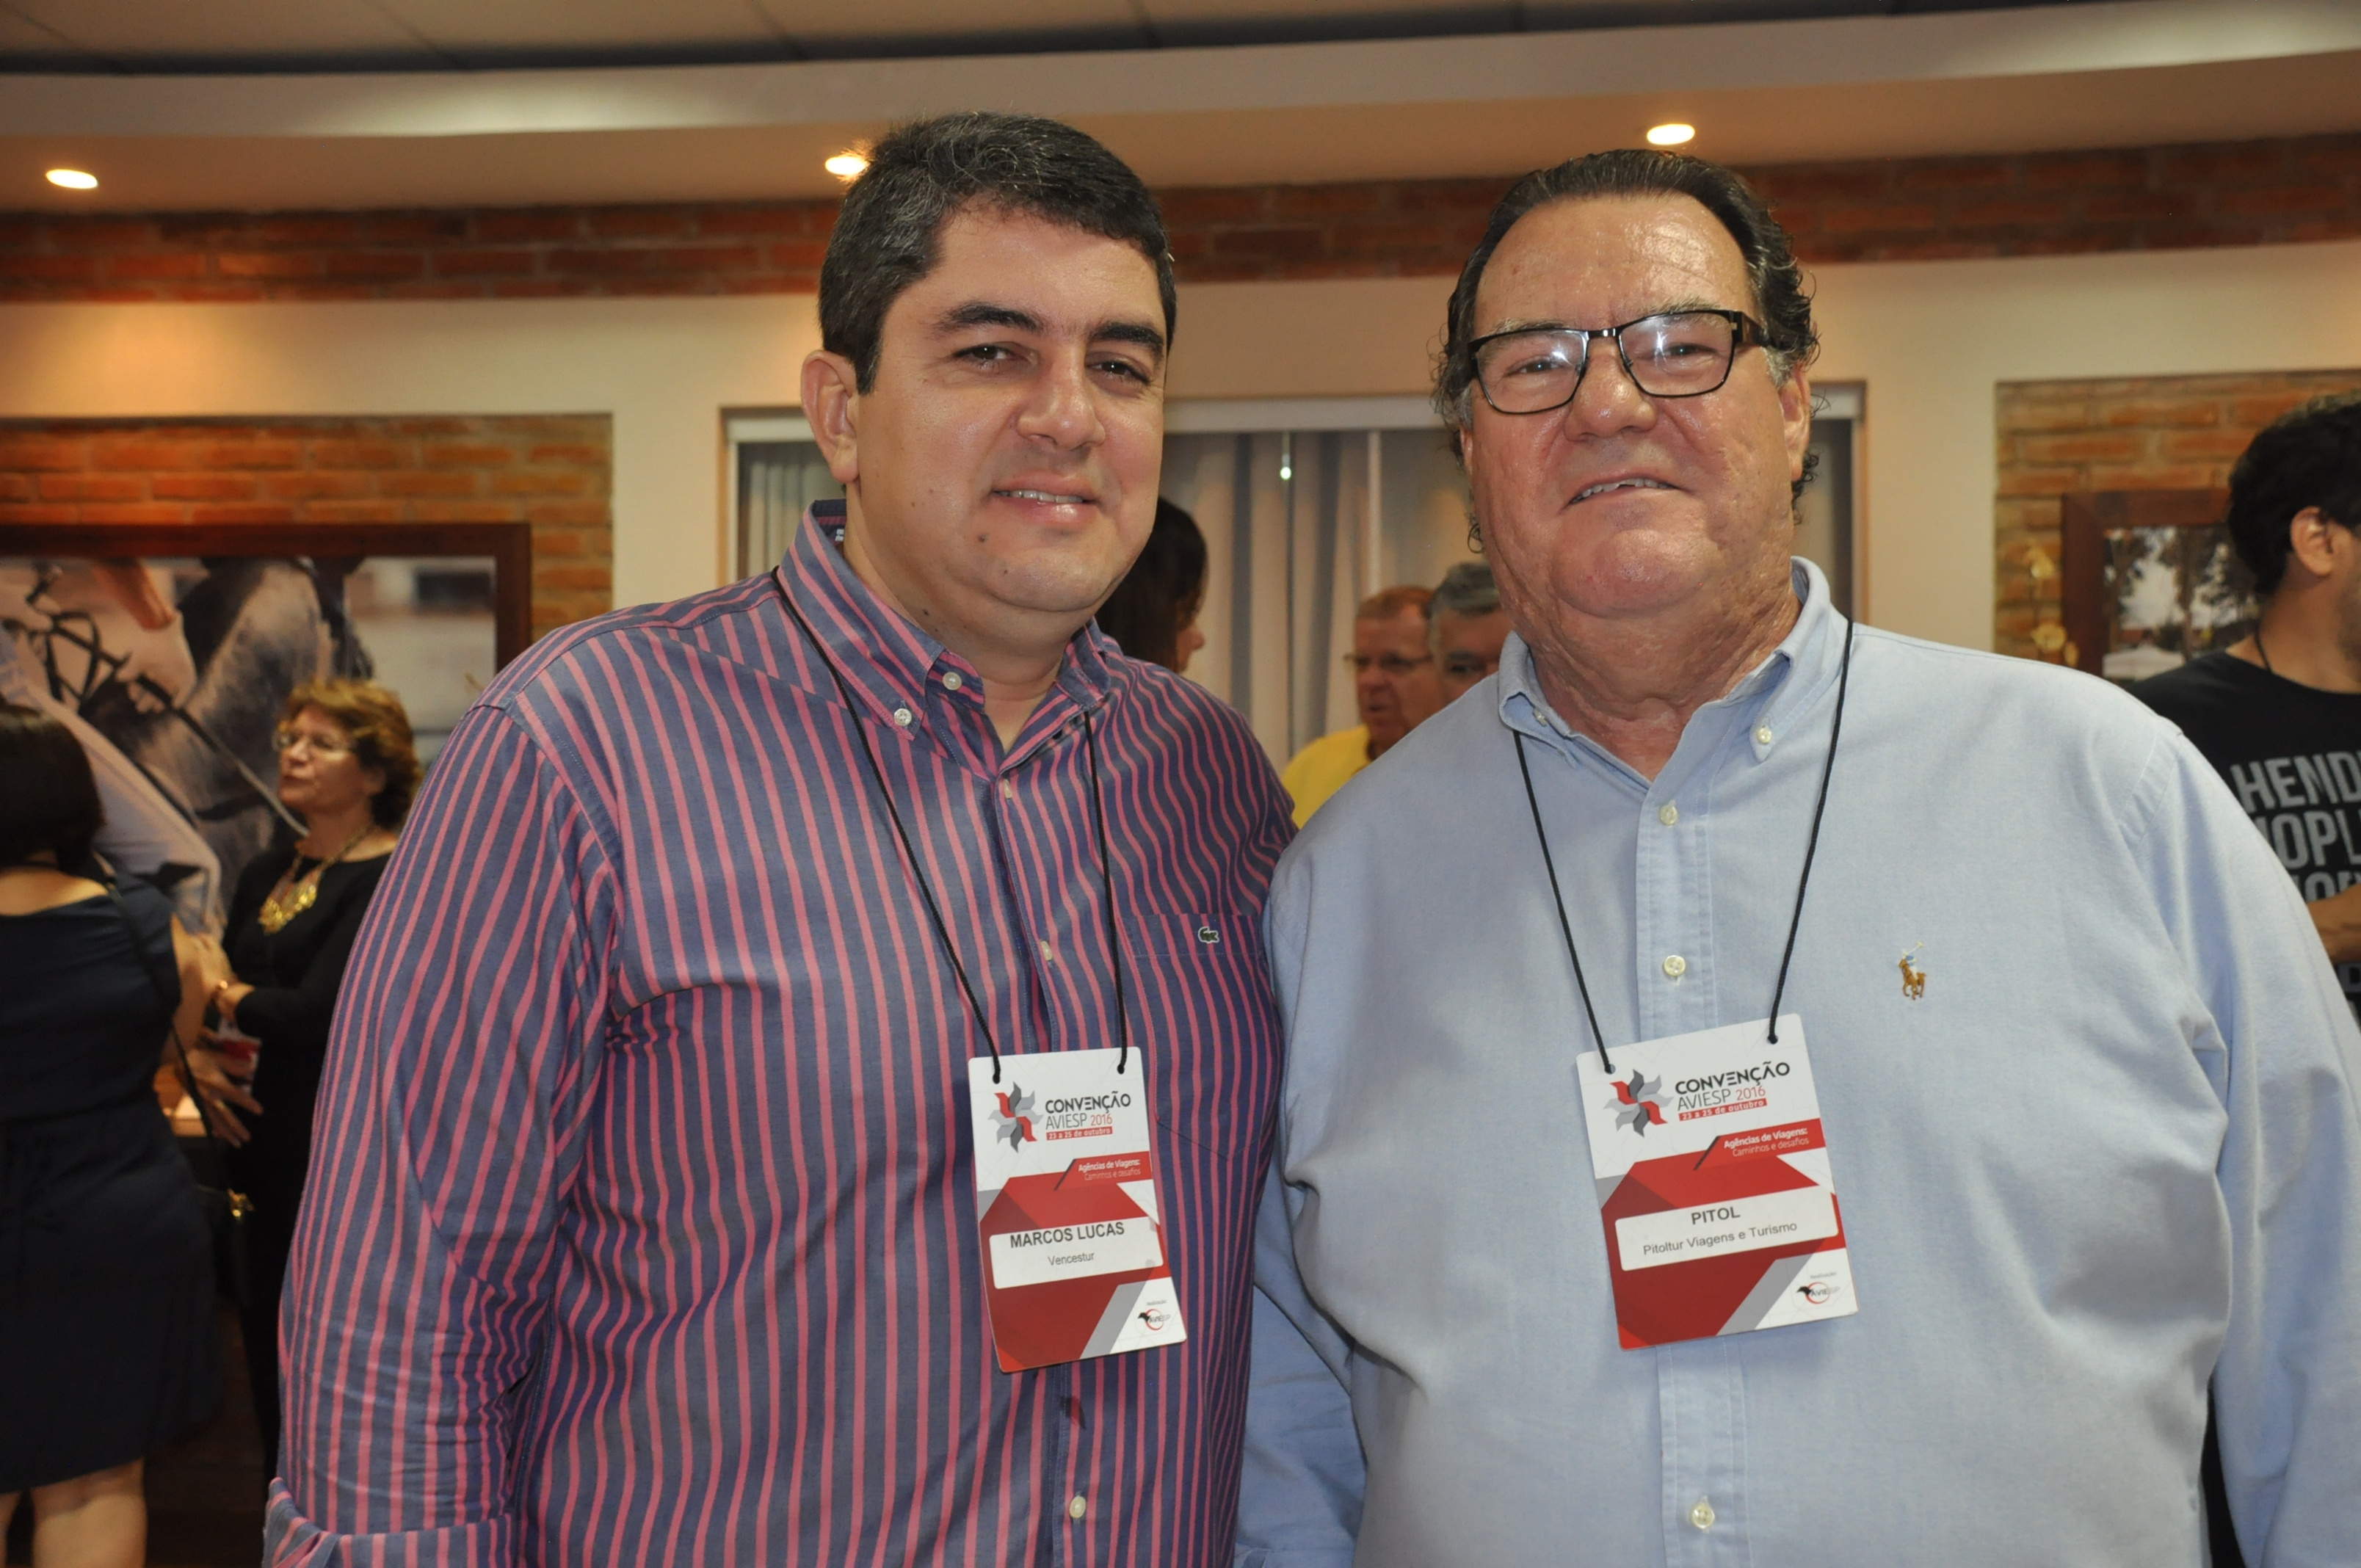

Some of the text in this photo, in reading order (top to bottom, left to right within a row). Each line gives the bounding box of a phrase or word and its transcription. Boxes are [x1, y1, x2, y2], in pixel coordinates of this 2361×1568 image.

[2230, 750, 2361, 813] HEND
[2255, 809, 2361, 870] OPL
[1675, 1061, 1790, 1095] CONVENÇÃO
[1045, 1091, 1131, 1114] CONVENÇÃO
[1678, 1085, 1766, 1111] AVIESP 2016
[1045, 1113, 1112, 1130] AVIESP 2016
[1682, 1113, 1692, 1121] 23
[1715, 1106, 1726, 1114] de
[1728, 1100, 1764, 1111] outubro
[1084, 1128, 1111, 1136] outubro
[1724, 1128, 1807, 1150] Agências de Viagens:
[1733, 1145, 1770, 1157] Caminhos
[1777, 1137, 1810, 1150] desafios
[1078, 1161, 1106, 1173] Agências
[1106, 1161, 1114, 1169] de
[1691, 1206, 1741, 1225] PITOL
[1010, 1222, 1125, 1248] MARCOS LUCAS
[1643, 1222, 1797, 1255] Pitoltur Viagens e Turismo
[1048, 1252, 1095, 1266] Vencestur
